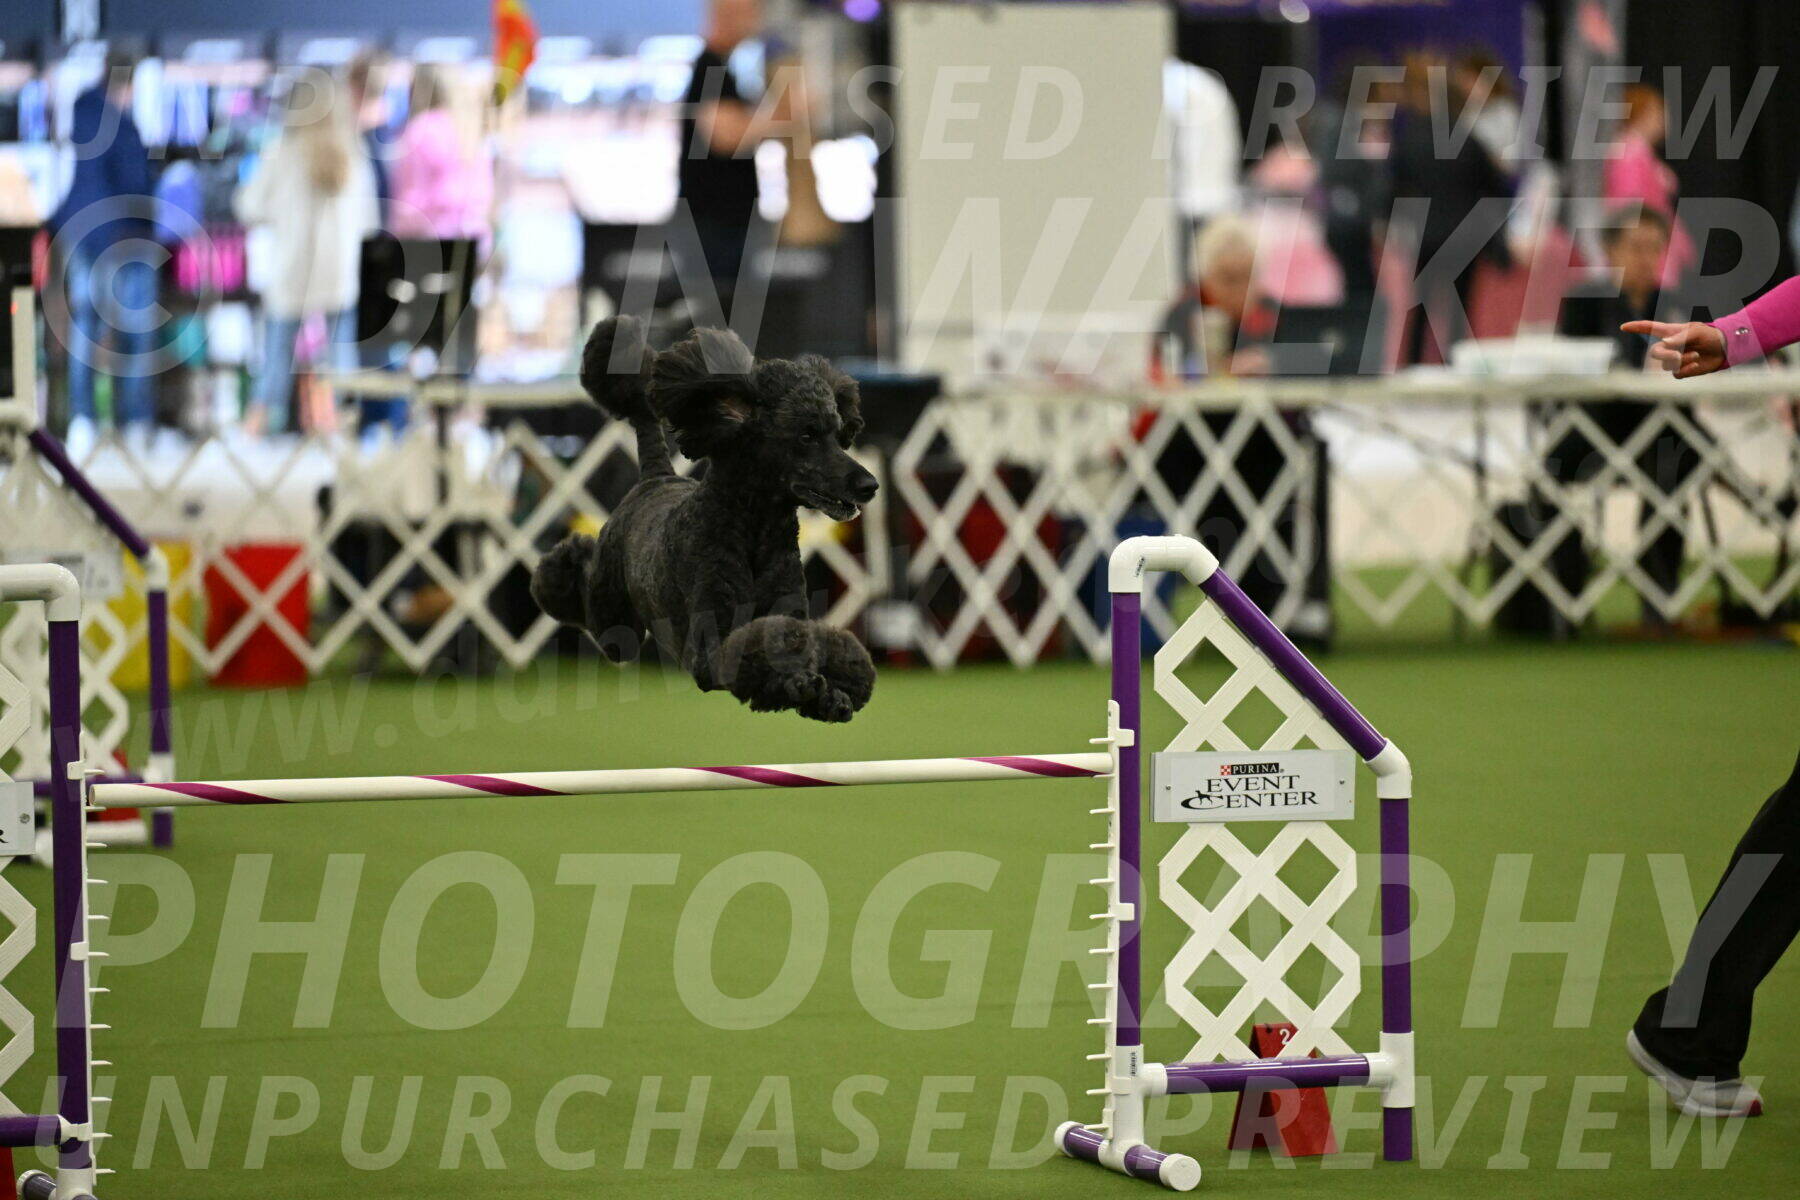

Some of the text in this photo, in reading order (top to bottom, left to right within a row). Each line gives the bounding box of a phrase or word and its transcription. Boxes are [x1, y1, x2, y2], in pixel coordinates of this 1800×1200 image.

[1232, 763, 1279, 775] PURINA
[1205, 775, 1300, 793] EVENT
[1180, 791, 1320, 810] CENTER
[1279, 1028, 1292, 1046] 2
